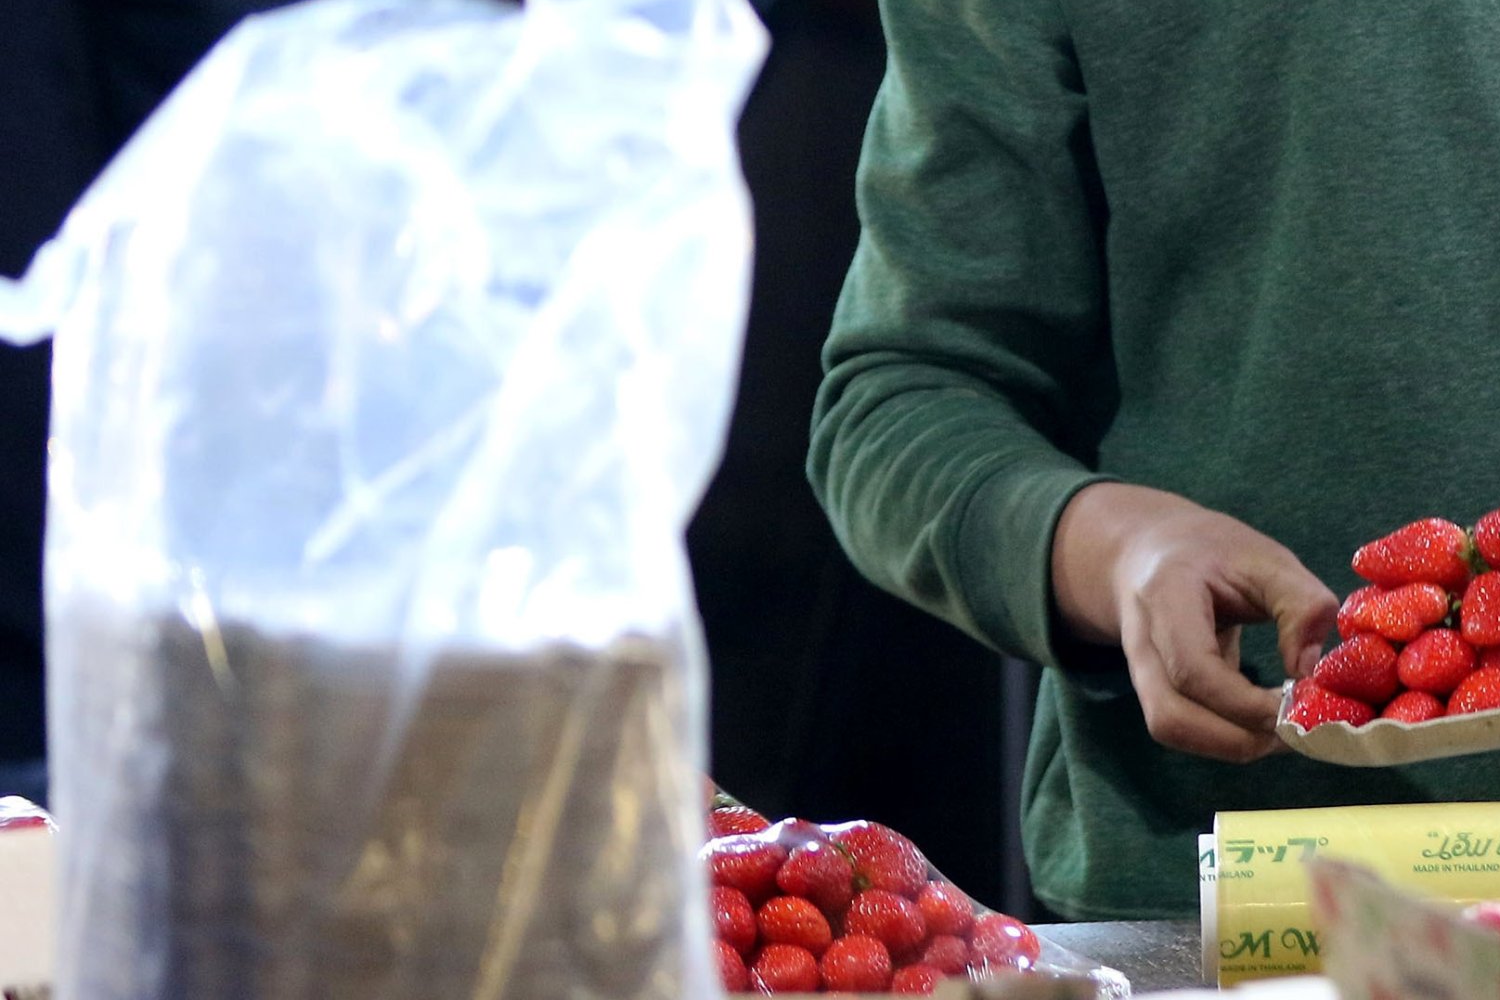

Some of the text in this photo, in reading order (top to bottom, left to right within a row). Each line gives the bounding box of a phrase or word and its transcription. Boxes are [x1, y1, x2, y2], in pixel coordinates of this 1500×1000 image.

[1412, 863, 1500, 873] MADE IN THAILAND
[1219, 929, 1275, 959] M
